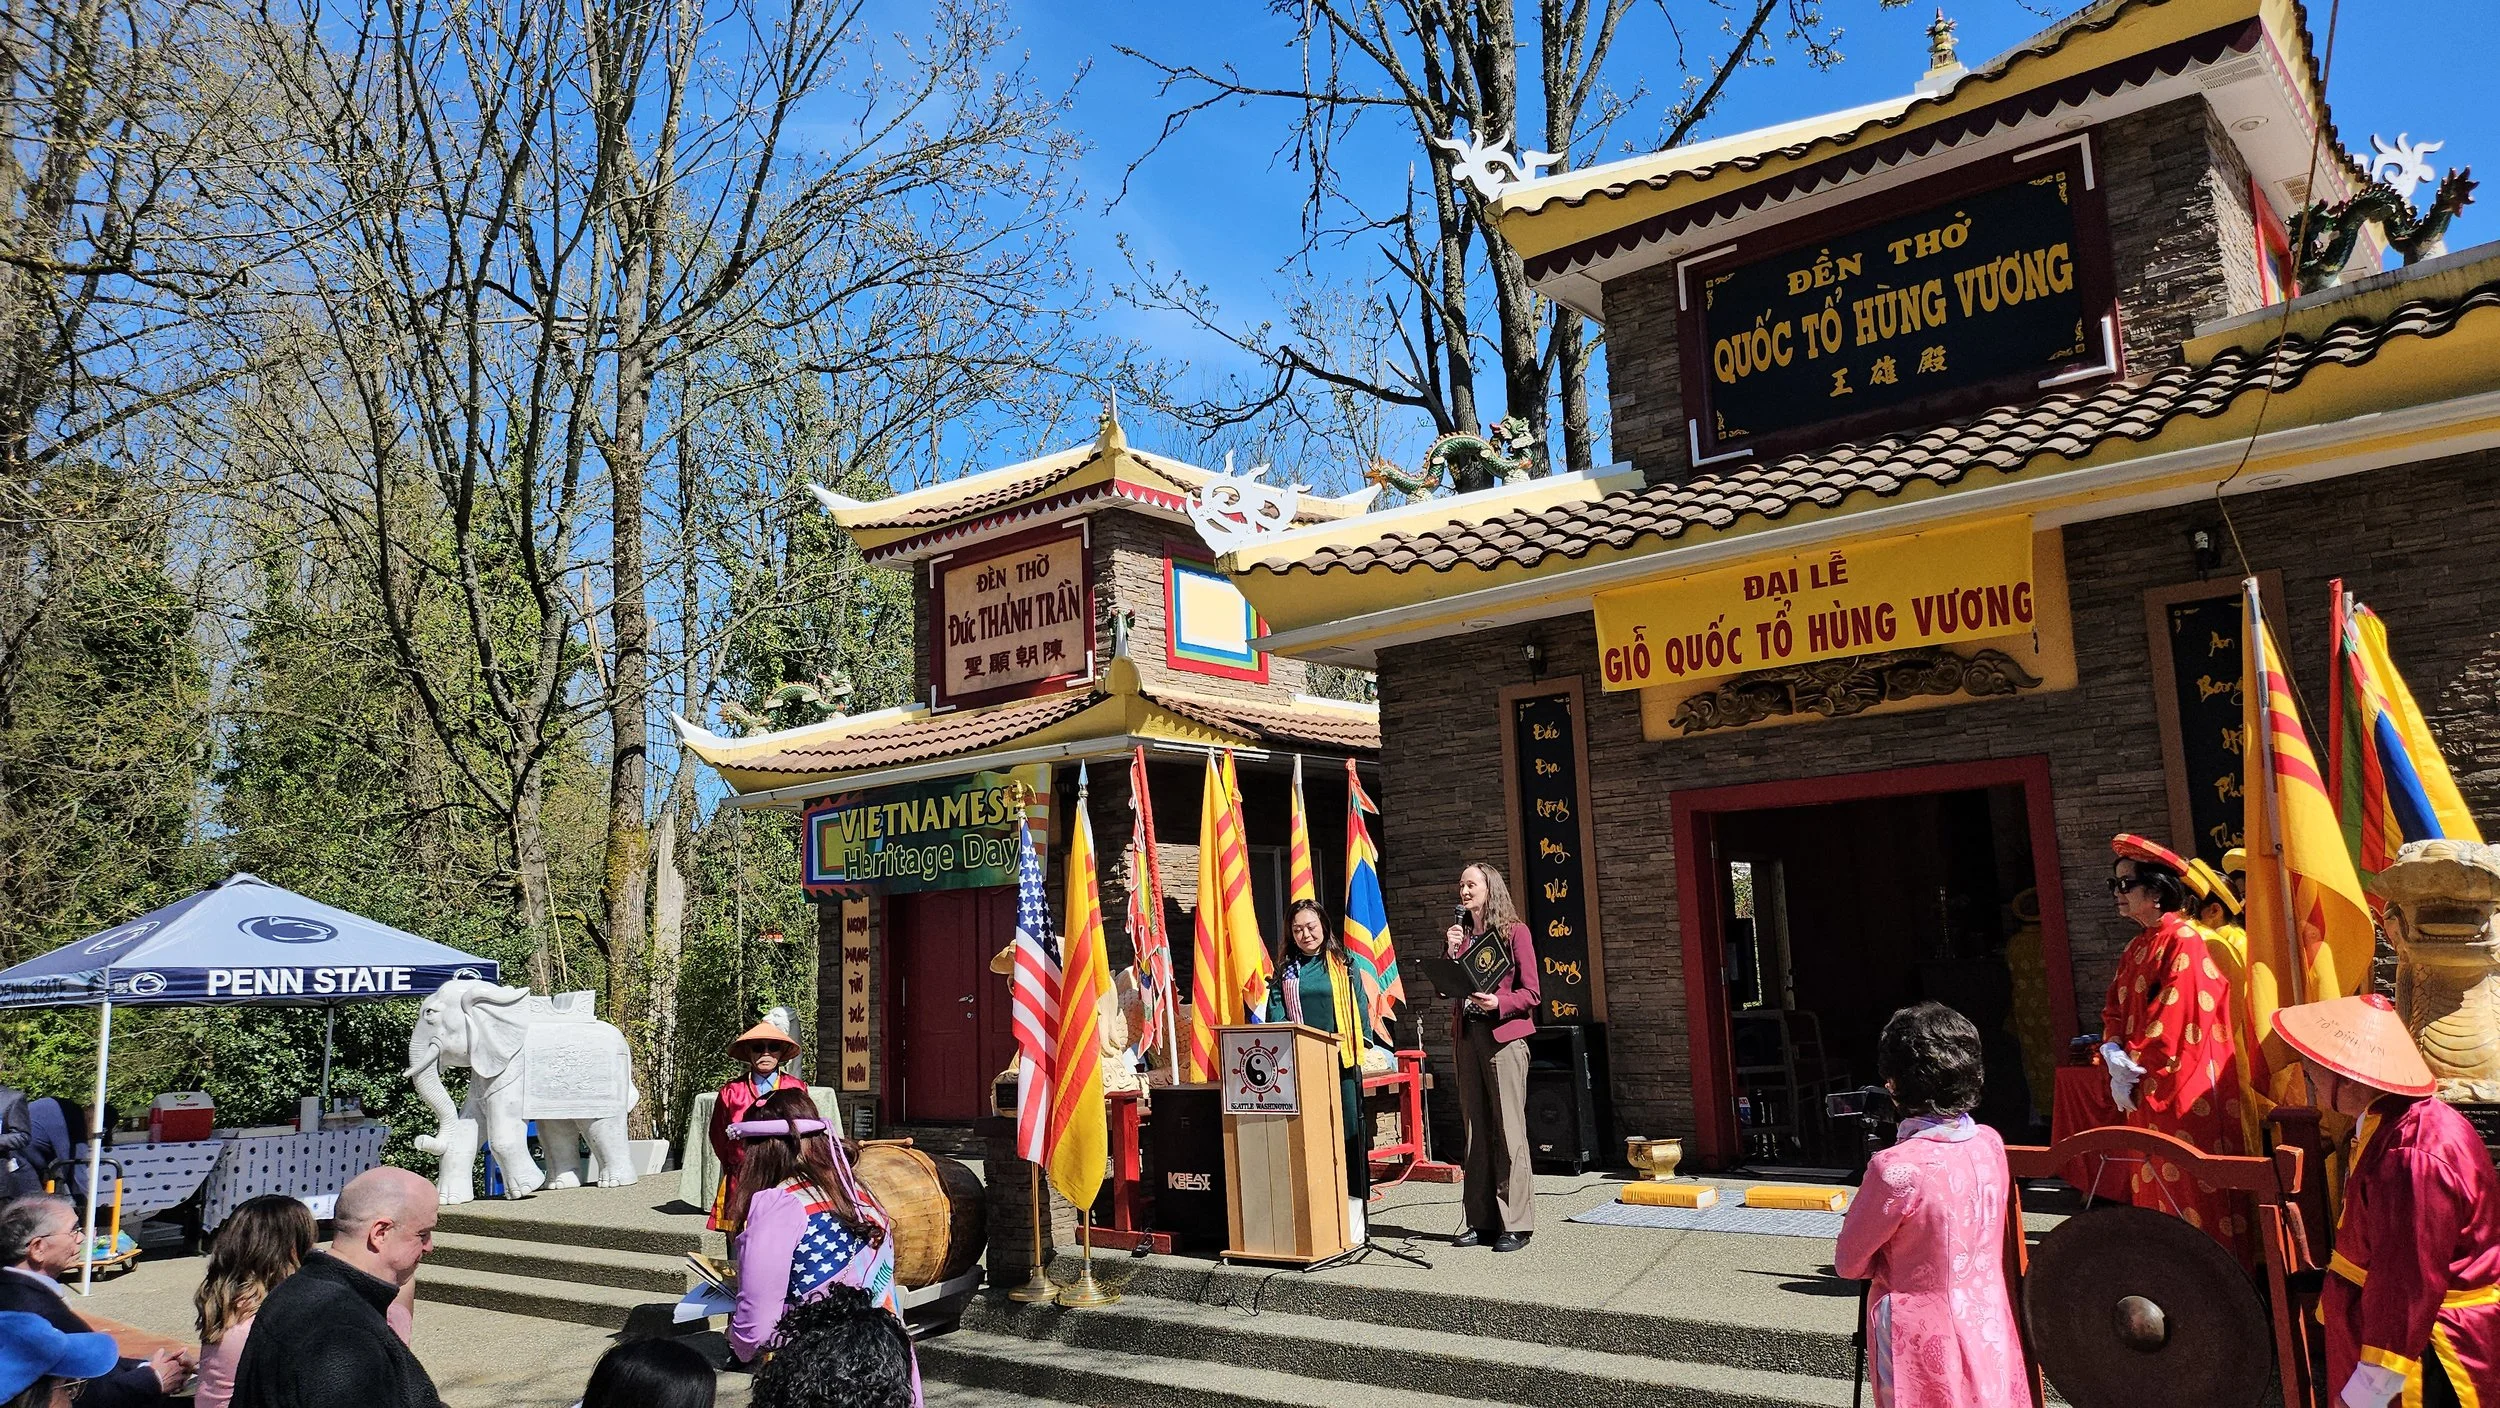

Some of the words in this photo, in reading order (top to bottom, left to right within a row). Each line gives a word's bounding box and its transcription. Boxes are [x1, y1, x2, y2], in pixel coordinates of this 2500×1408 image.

[1787, 248, 1862, 296] ĐỀN
[1888, 210, 1972, 263] THỜ
[1713, 308, 1794, 384] QUỐC
[1801, 285, 1844, 359] TỔ
[1853, 279, 1948, 347] HÙNG
[1954, 242, 2074, 317] VƯƠNG
[1016, 553, 1050, 583] THỜ
[1743, 568, 1798, 602] ĐẠI
[1811, 549, 1849, 589] LỄ
[978, 592, 1033, 641] THÁNH
[1036, 579, 1081, 628] TRẦN
[1604, 625, 1651, 684] GIỖ
[1665, 614, 1743, 677] QUỐC
[1756, 600, 1793, 660] TỔ
[1808, 600, 1897, 653] HÙNG
[1912, 581, 2033, 637] VƯƠNG
[843, 843, 954, 882] Heritage
[962, 833, 1020, 875] Day
[1540, 837, 1571, 864] Bay
[208, 968, 304, 996] PENN
[313, 967, 412, 994] STATE
[1231, 1102, 1254, 1110] SEATTLE
[1256, 1102, 1293, 1110] WASHINGTON
